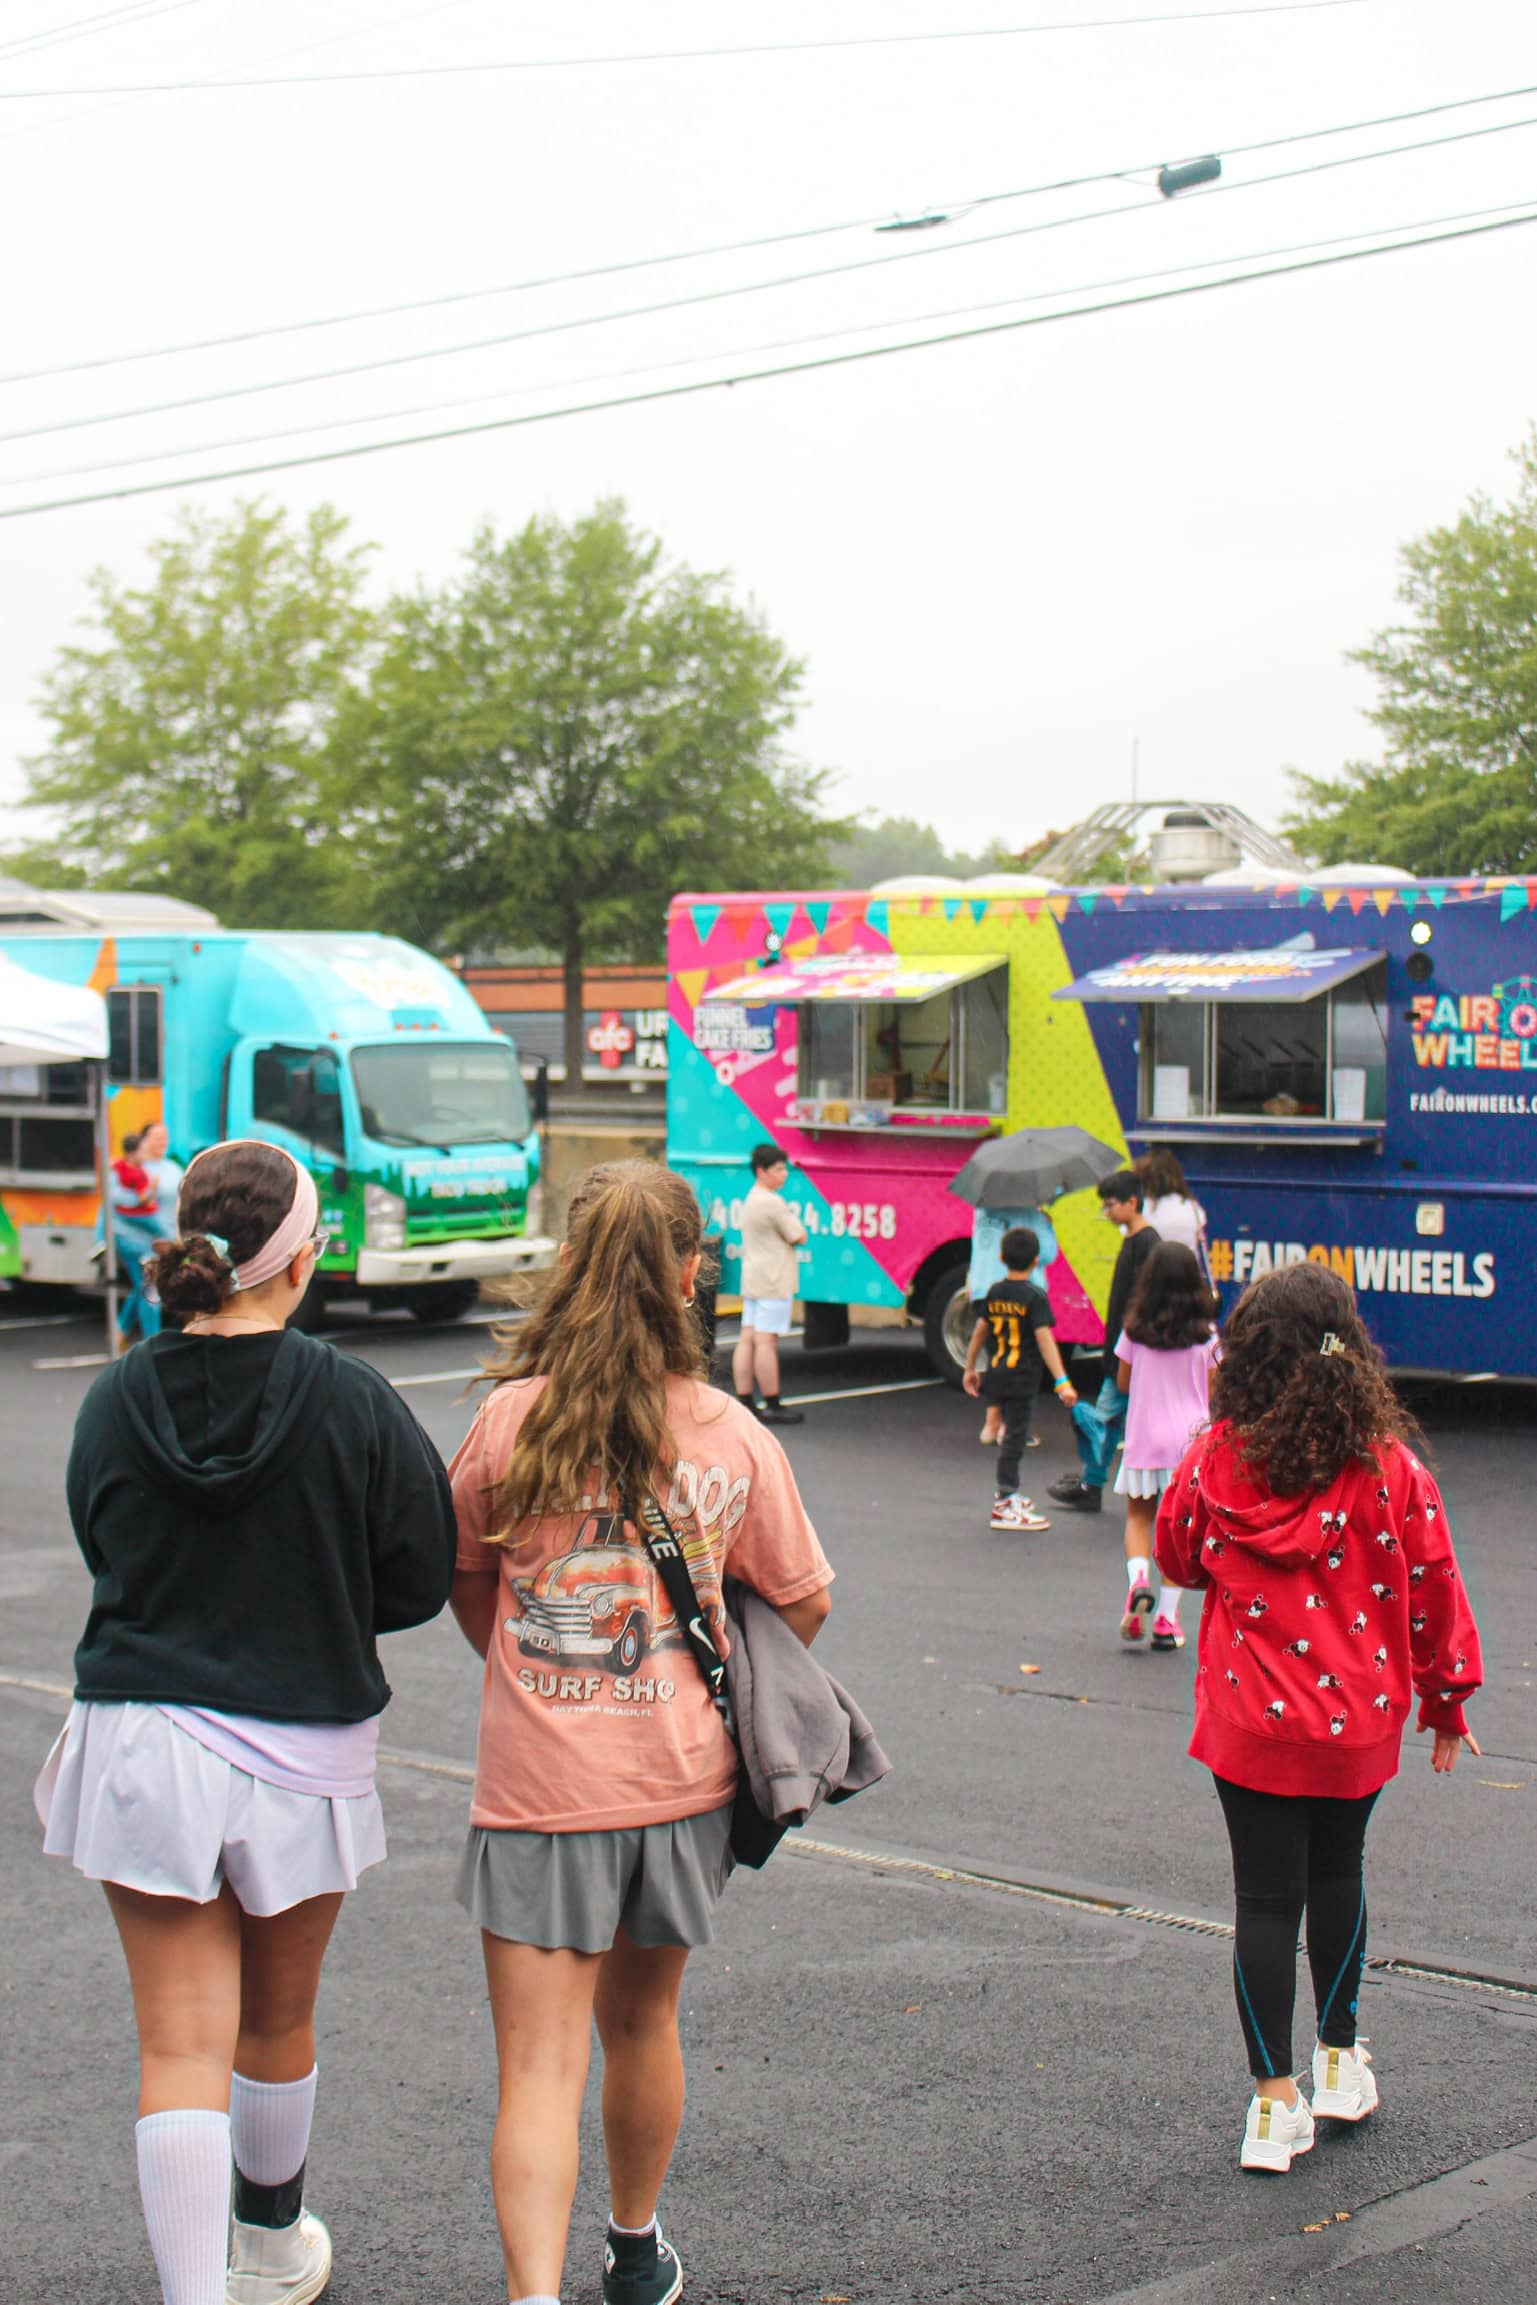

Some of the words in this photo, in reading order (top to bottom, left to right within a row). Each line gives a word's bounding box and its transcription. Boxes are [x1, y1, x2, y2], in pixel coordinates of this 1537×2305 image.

[694, 1004, 748, 1028] FUNNEL
[1411, 994, 1499, 1032] FAIR
[694, 1027, 731, 1050] CAKE
[732, 1026, 773, 1050] FRIES
[1412, 1033, 1537, 1070] WHEEL
[518, 1668, 603, 1700] SURF
